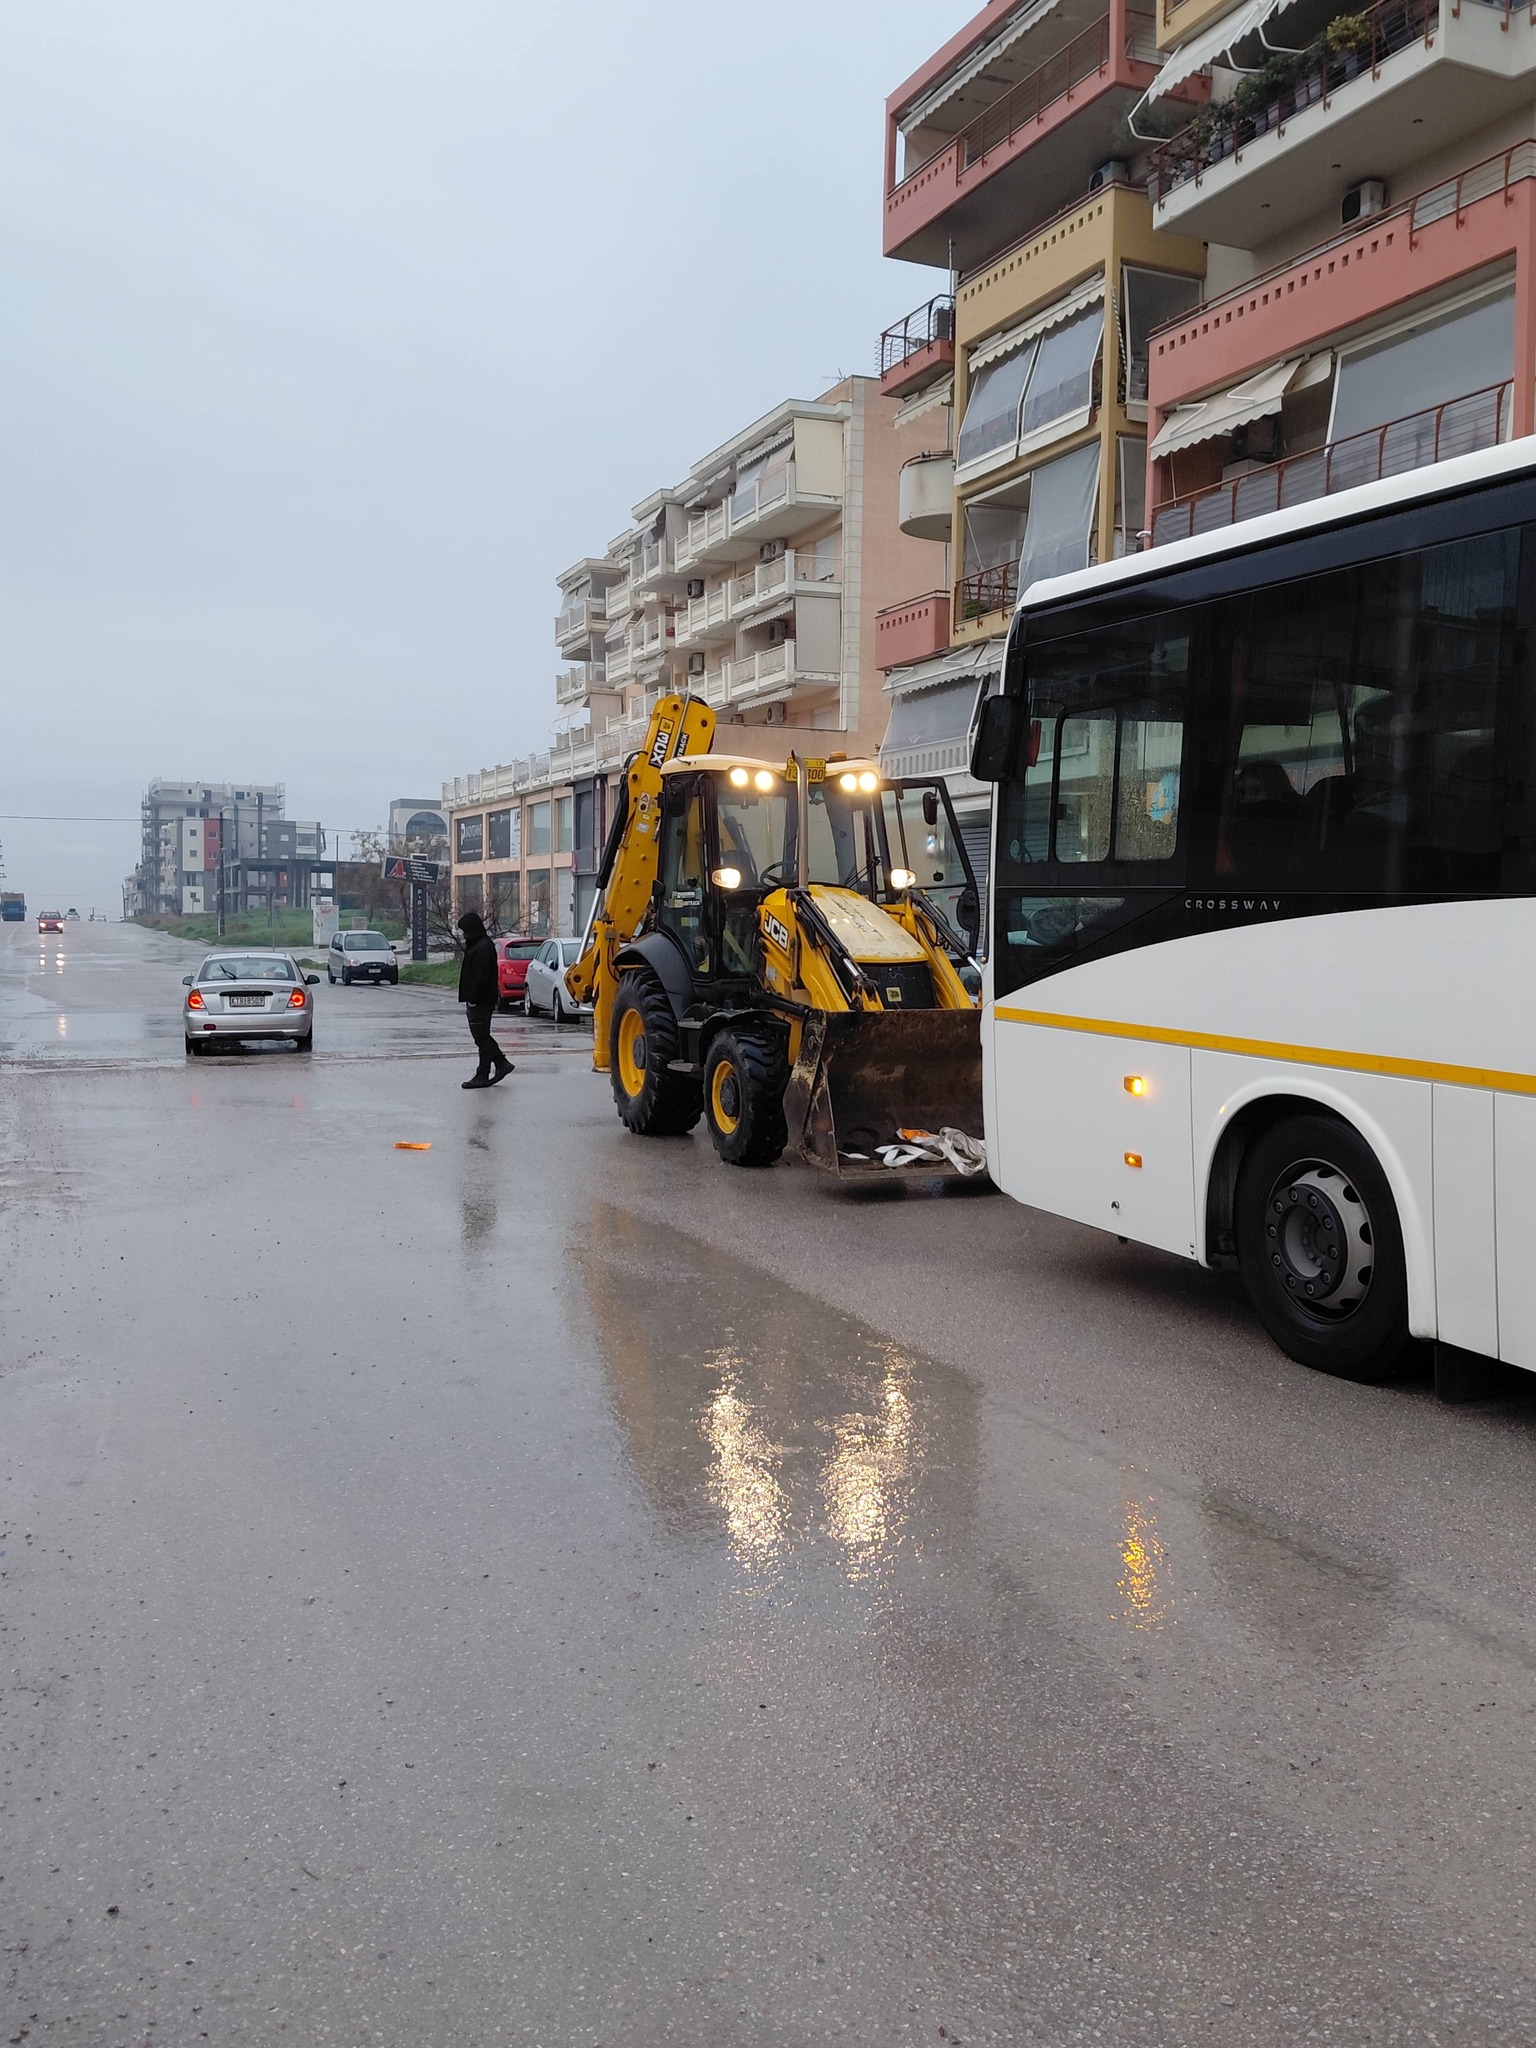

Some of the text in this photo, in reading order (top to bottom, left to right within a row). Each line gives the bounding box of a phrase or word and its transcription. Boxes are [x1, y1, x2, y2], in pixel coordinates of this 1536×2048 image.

[650, 732, 670, 765] 3CX
[1185, 899, 1280, 910] CROSSWAY
[764, 914, 788, 949] JCB
